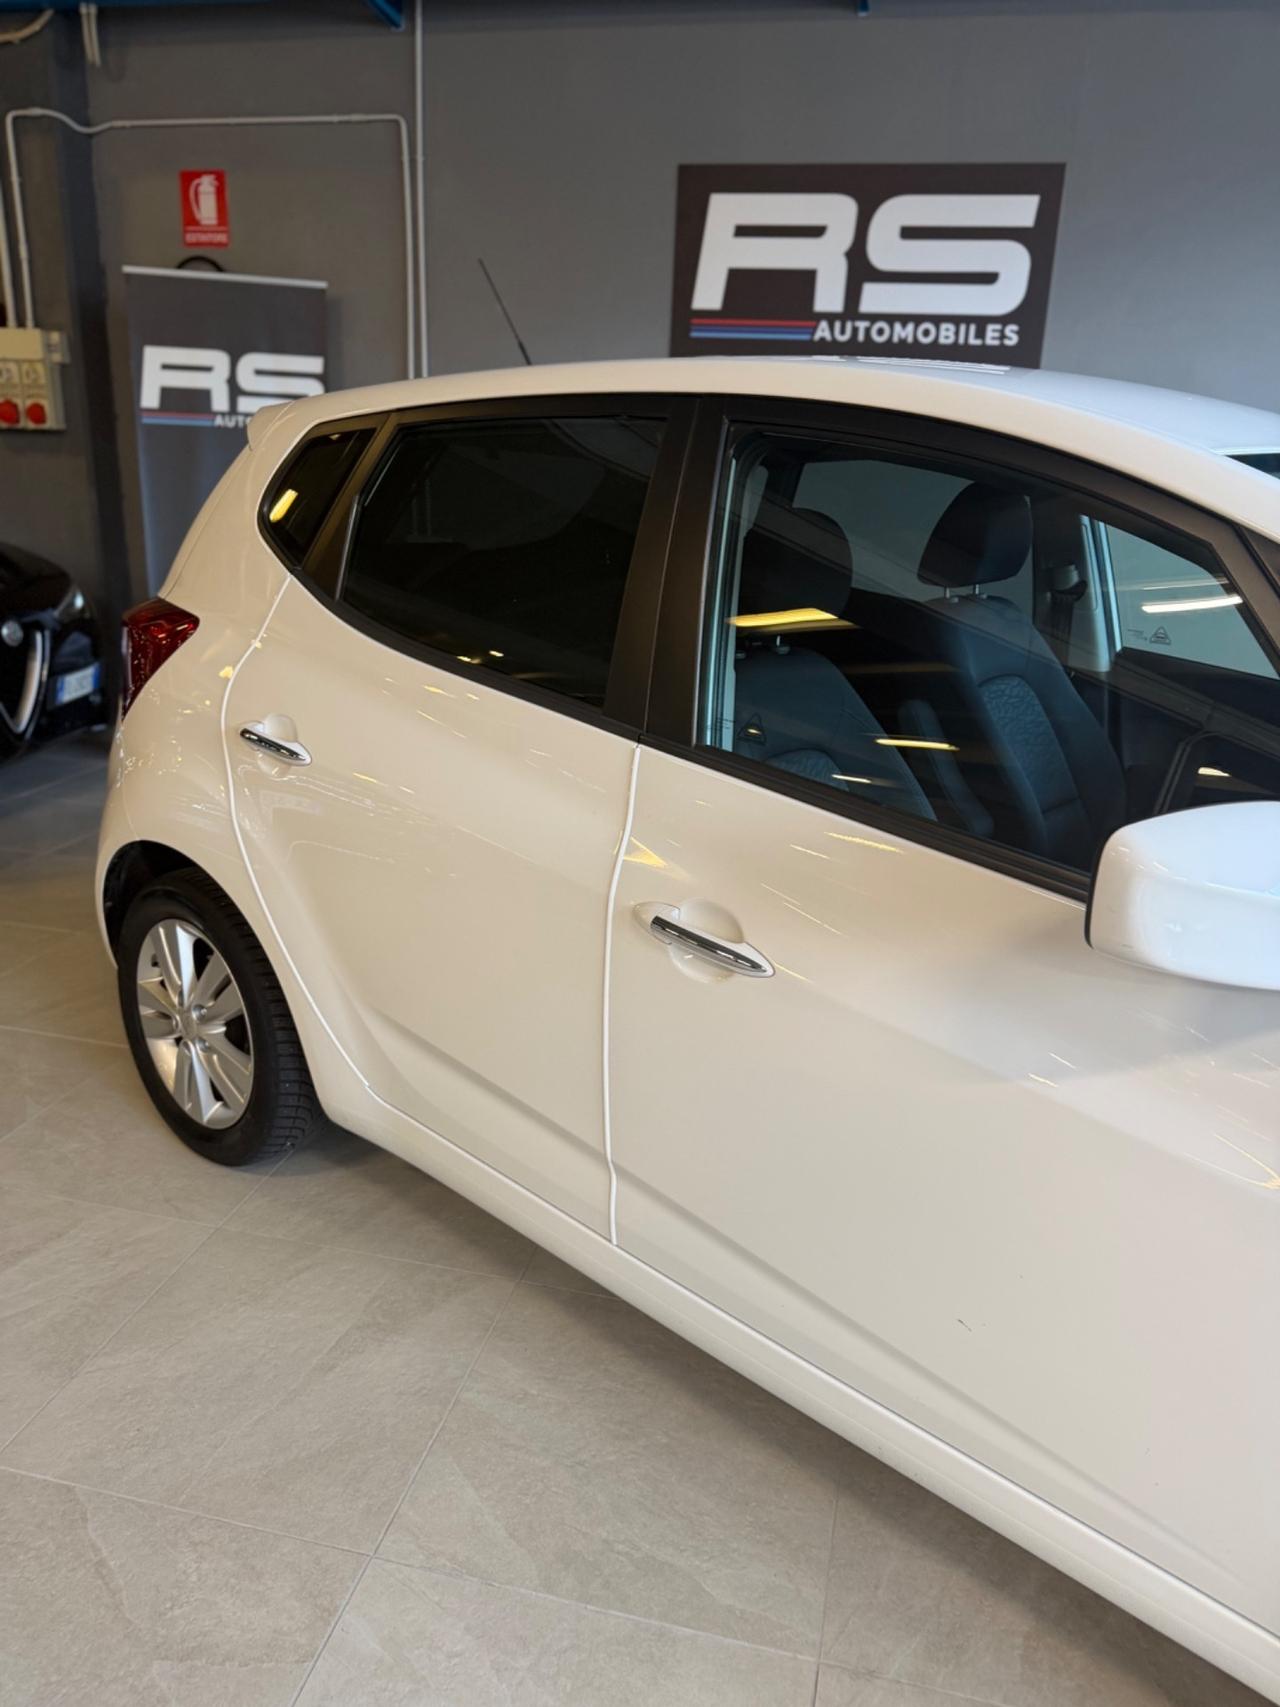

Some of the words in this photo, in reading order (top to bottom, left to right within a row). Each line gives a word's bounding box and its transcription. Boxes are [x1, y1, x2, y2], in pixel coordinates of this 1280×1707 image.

[691, 192, 1041, 316] RS
[813, 319, 1020, 346] AUTOMOBILES
[139, 345, 326, 413] RS
